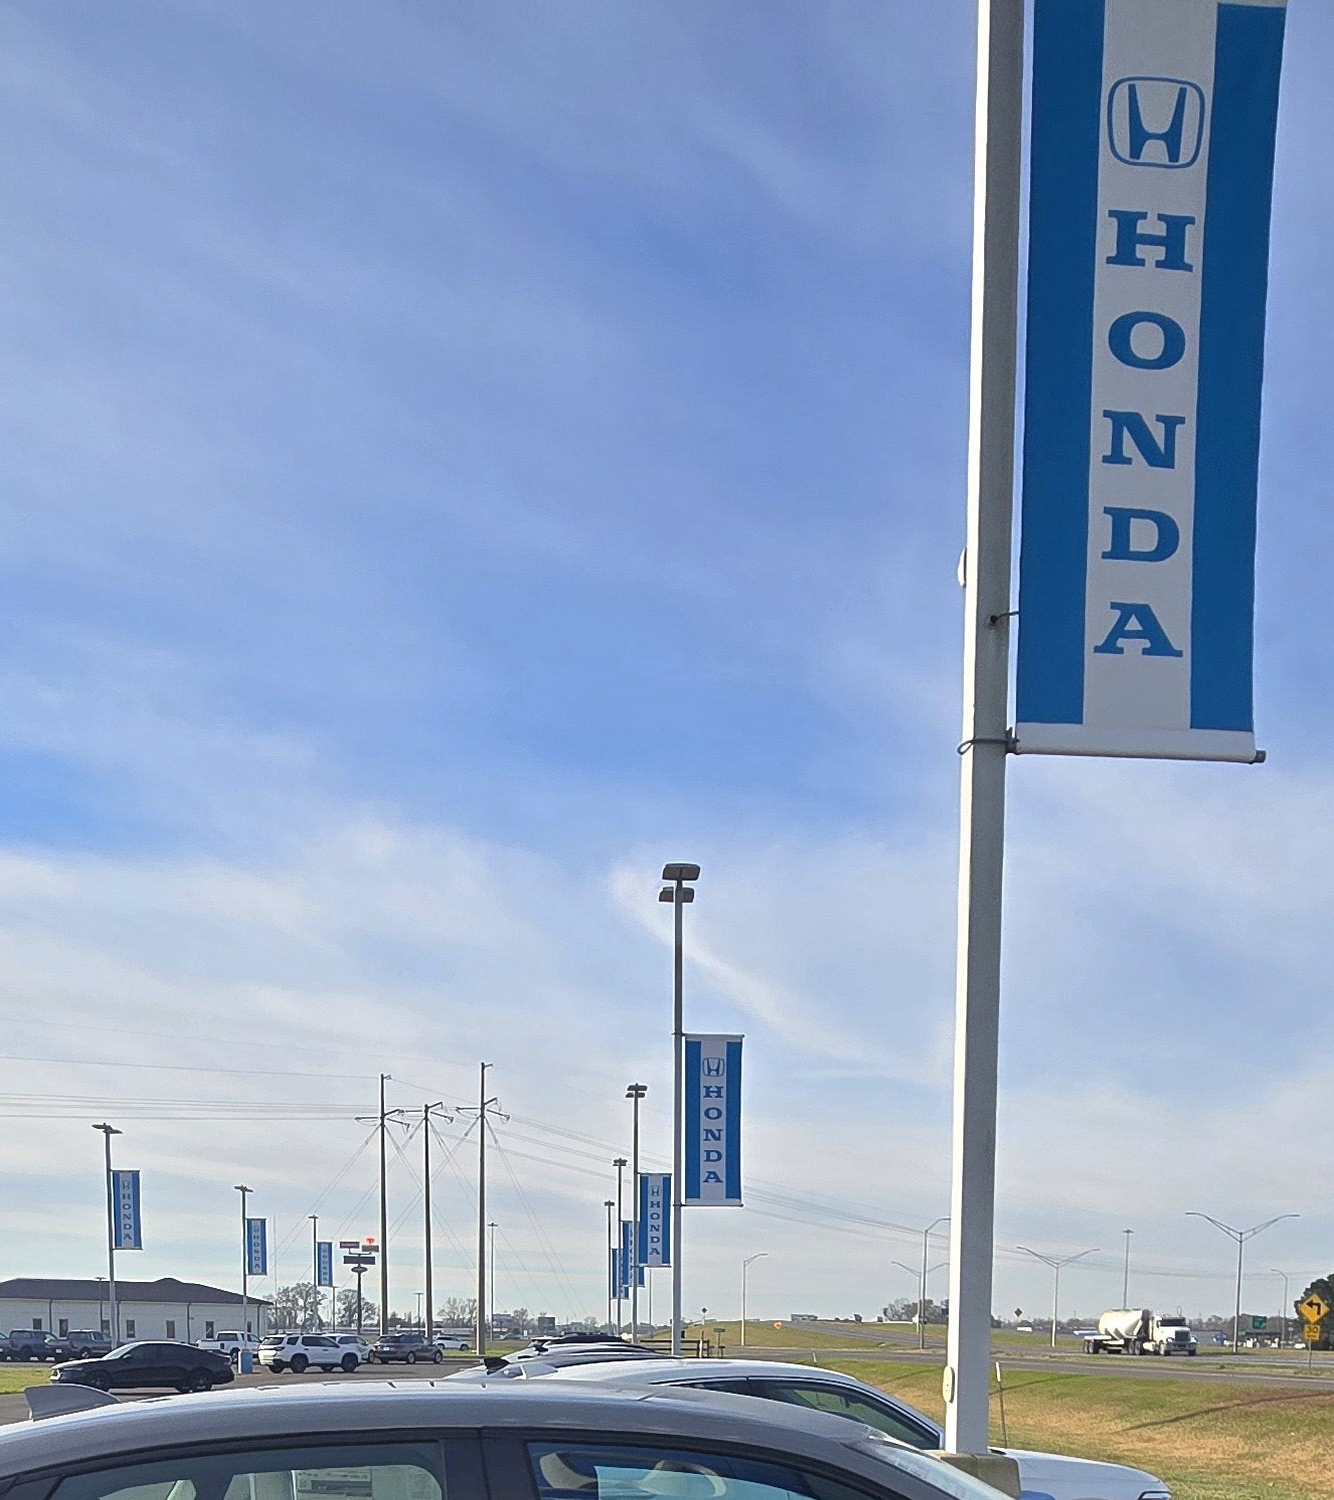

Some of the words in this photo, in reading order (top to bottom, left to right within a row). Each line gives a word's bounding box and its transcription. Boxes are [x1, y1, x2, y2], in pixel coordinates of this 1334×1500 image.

[1093, 209, 1196, 658] HONDA
[702, 1085, 724, 1183] HONDA
[122, 1193, 132, 1240] HONDA
[649, 1200, 661, 1256] HONDA
